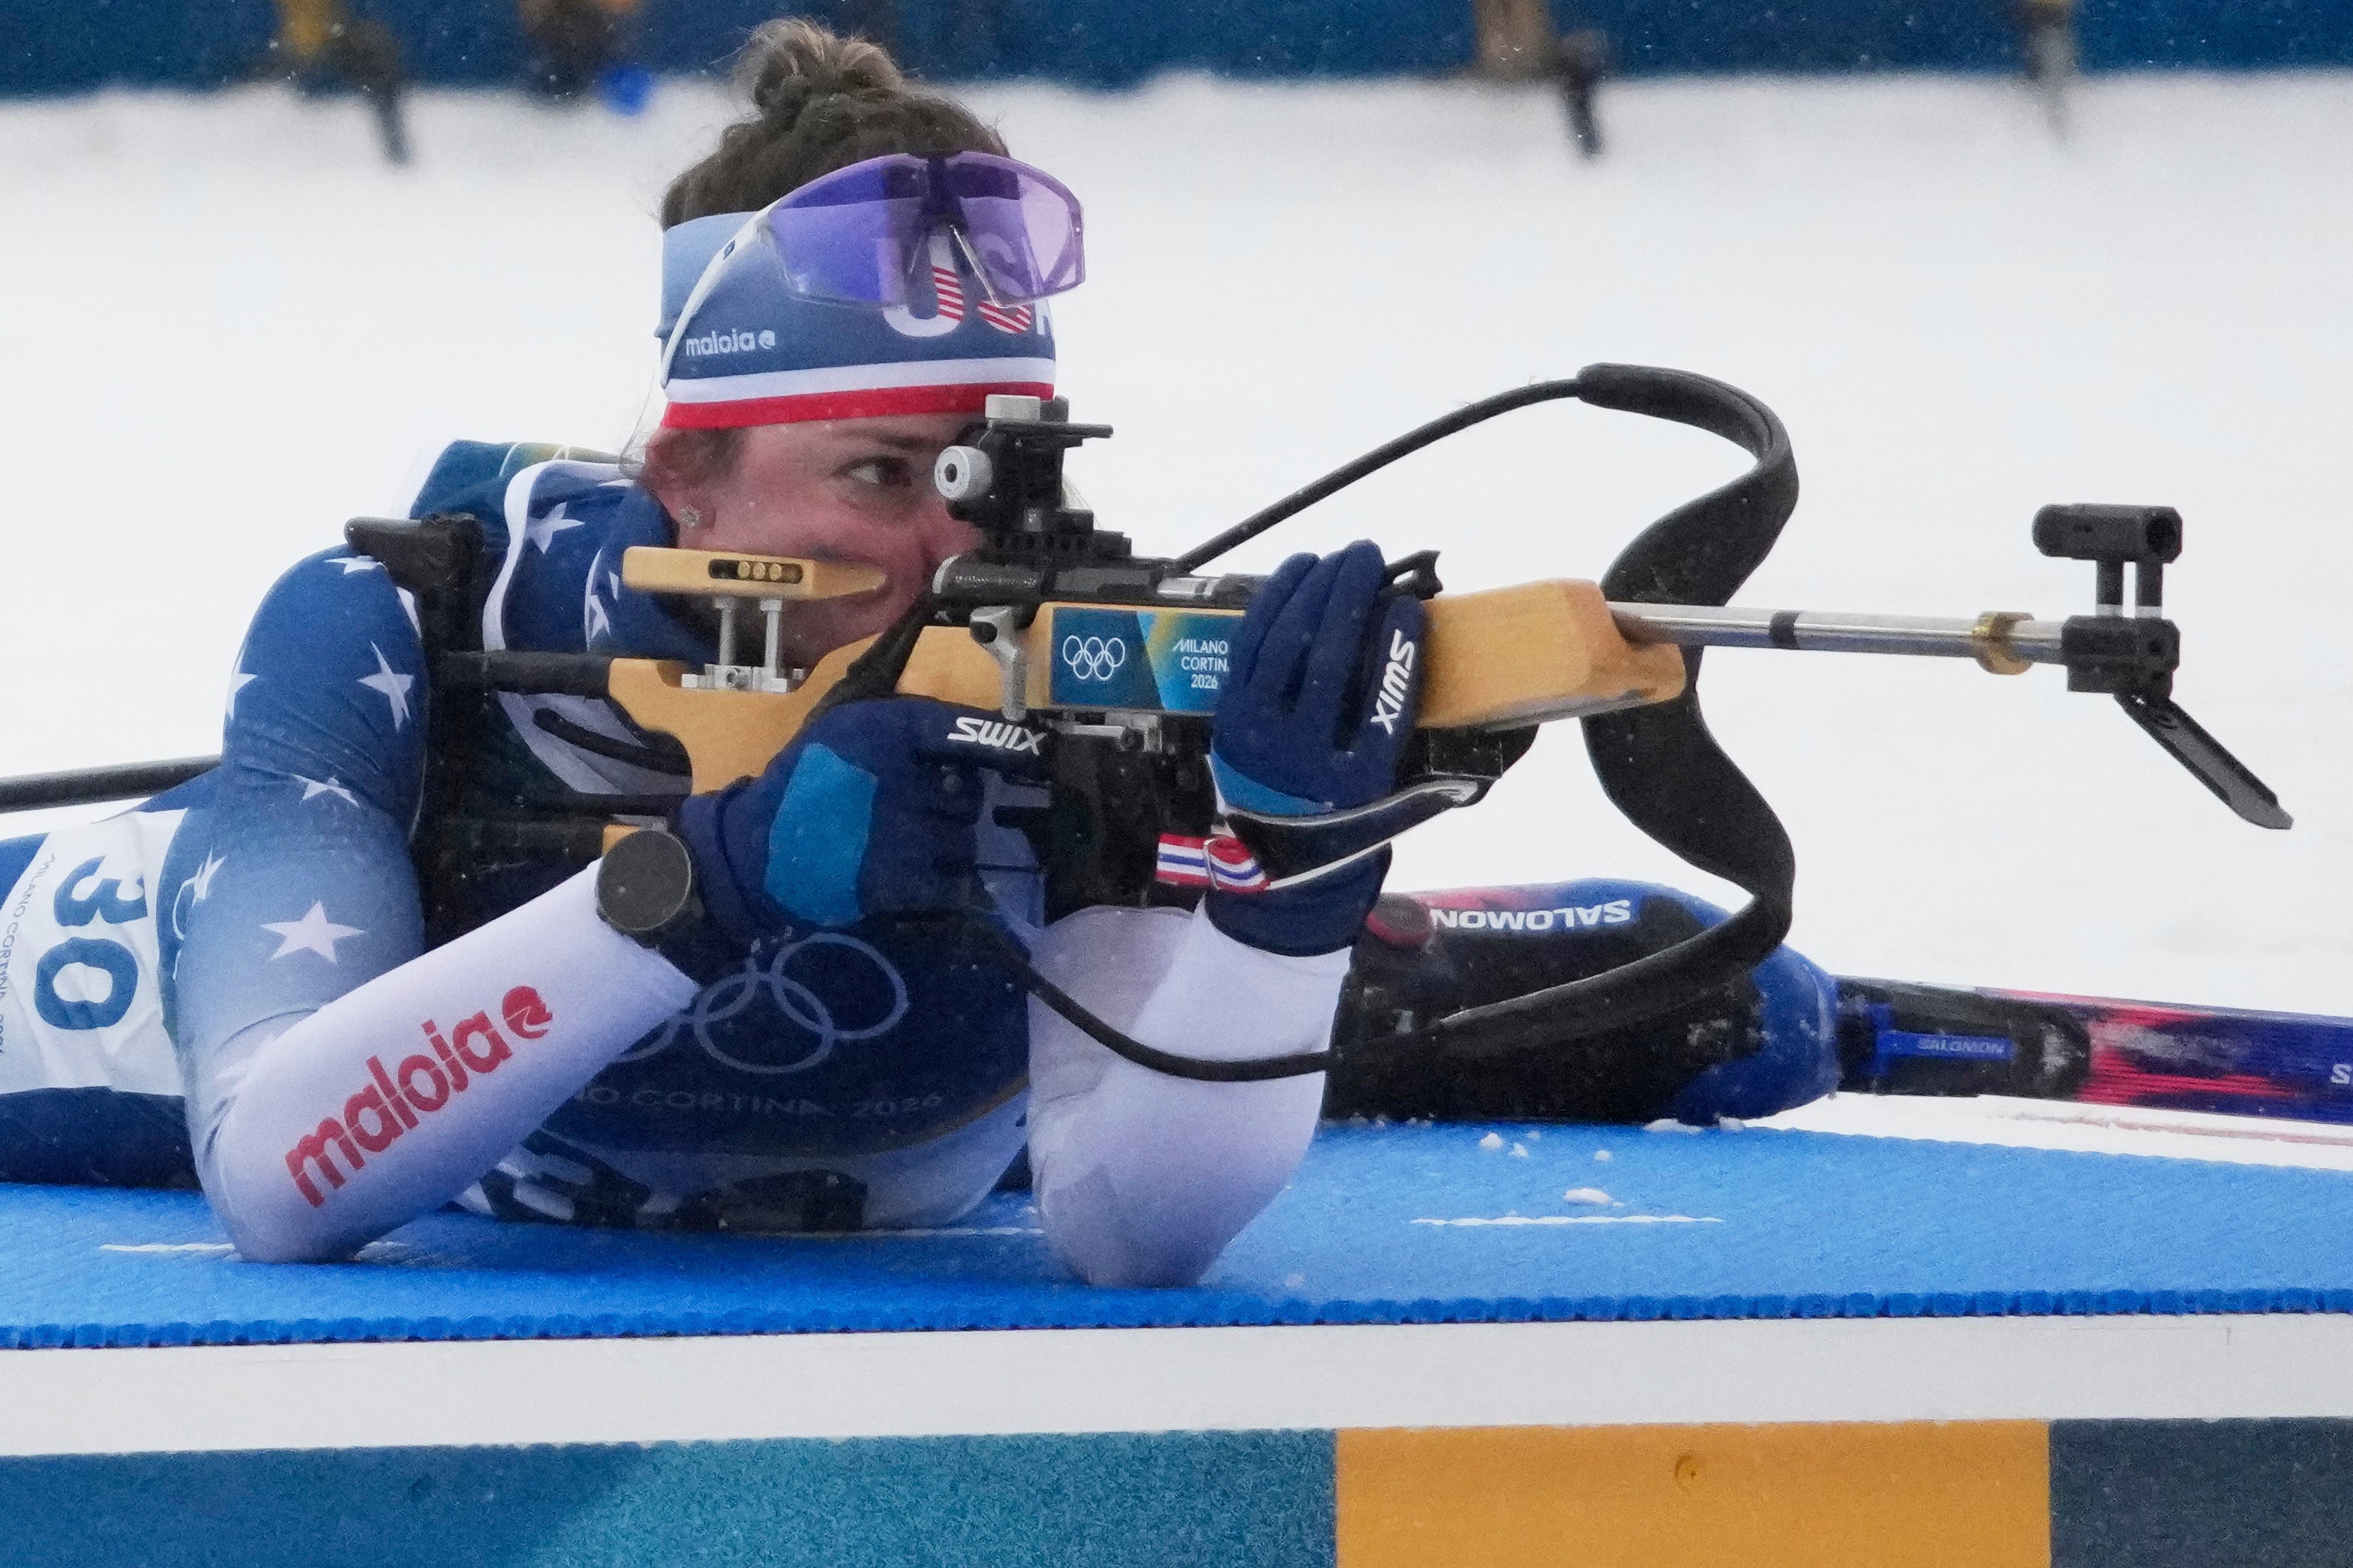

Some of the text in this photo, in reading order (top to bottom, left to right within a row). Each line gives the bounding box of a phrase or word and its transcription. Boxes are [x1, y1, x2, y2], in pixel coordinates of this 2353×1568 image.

[686, 328, 755, 356] maloja
[1172, 638, 1229, 655] MILANO
[1181, 656, 1230, 672] CORTIN
[1190, 673, 1218, 689] 2026
[1370, 628, 1415, 735] SWIX
[947, 716, 1047, 755] SWIX
[13, 853, 56, 918] MILANO
[1429, 899, 1632, 931] SALOMON
[34, 855, 149, 1031] 30
[285, 1010, 513, 1208] maloja
[631, 1089, 836, 1117] CORTINA
